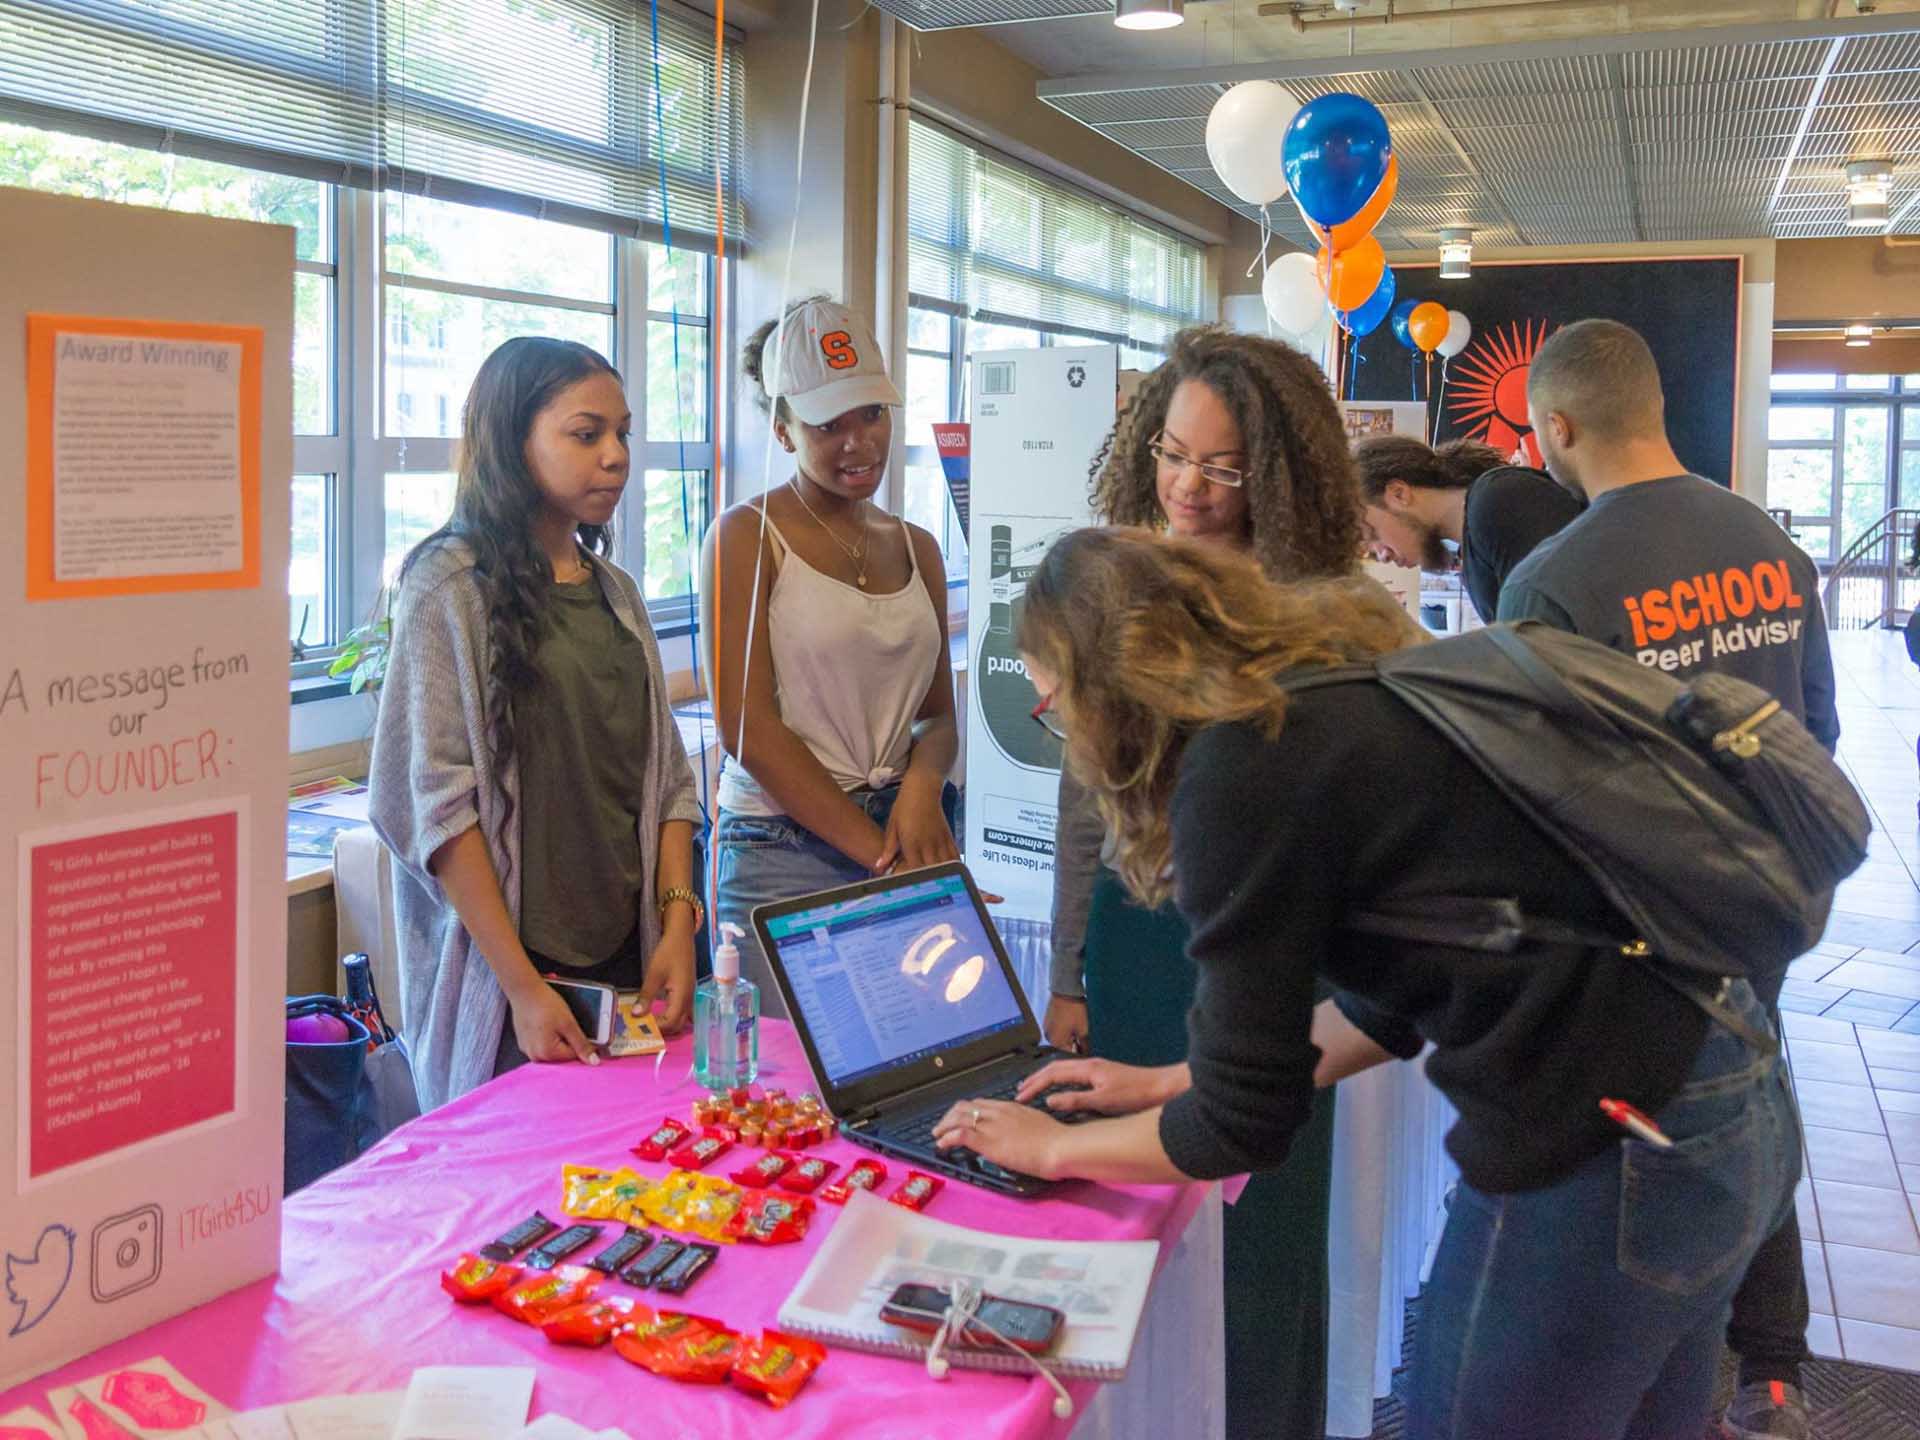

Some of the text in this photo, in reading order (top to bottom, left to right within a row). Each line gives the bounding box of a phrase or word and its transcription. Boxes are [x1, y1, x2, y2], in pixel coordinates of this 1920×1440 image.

[60, 337, 231, 373] Award Winning
[820, 330, 858, 370] S
[1623, 559, 1803, 648] iSCHOOL
[1636, 617, 1803, 671] Peer Advisr
[0, 647, 249, 714] A message from
[109, 711, 149, 737] our
[35, 728, 234, 809] FOUNDER:
[983, 850, 999, 863] Life
[1001, 853, 1010, 864] to
[1012, 856, 1038, 871] Ideas
[71, 916, 102, 932] need
